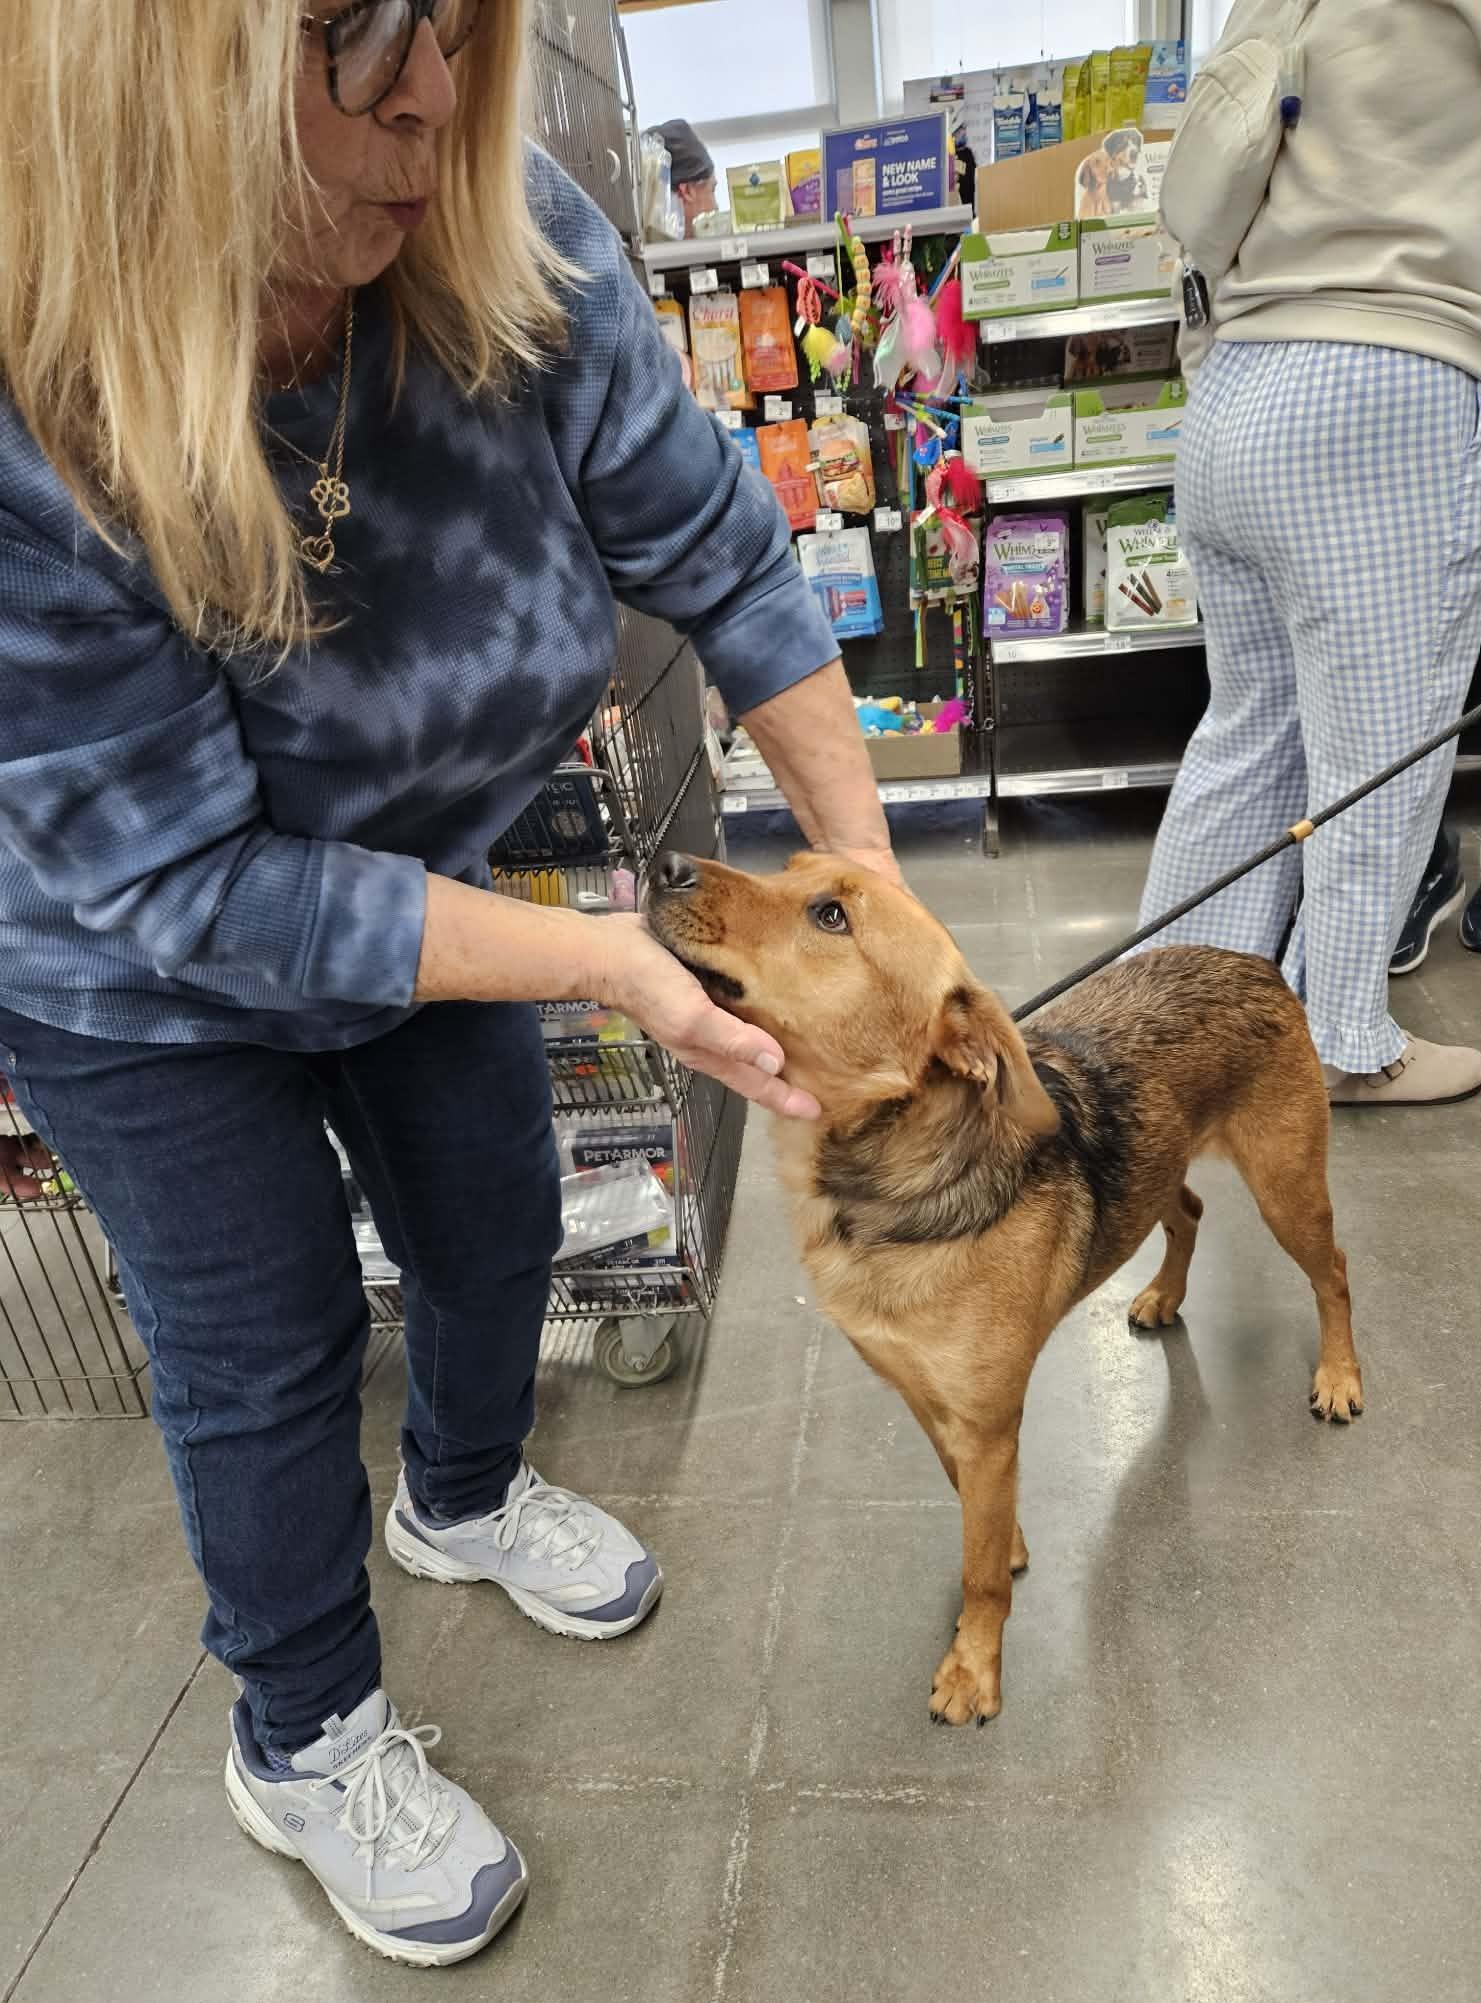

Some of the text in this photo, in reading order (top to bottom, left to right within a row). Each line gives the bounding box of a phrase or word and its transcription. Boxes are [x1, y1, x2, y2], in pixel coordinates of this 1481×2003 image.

[882, 157, 937, 176] NEW NAME
[882, 172, 919, 188] & LOOK
[536, 1001, 600, 1016] TARMOR
[584, 1147, 665, 1162] PETARMOR
